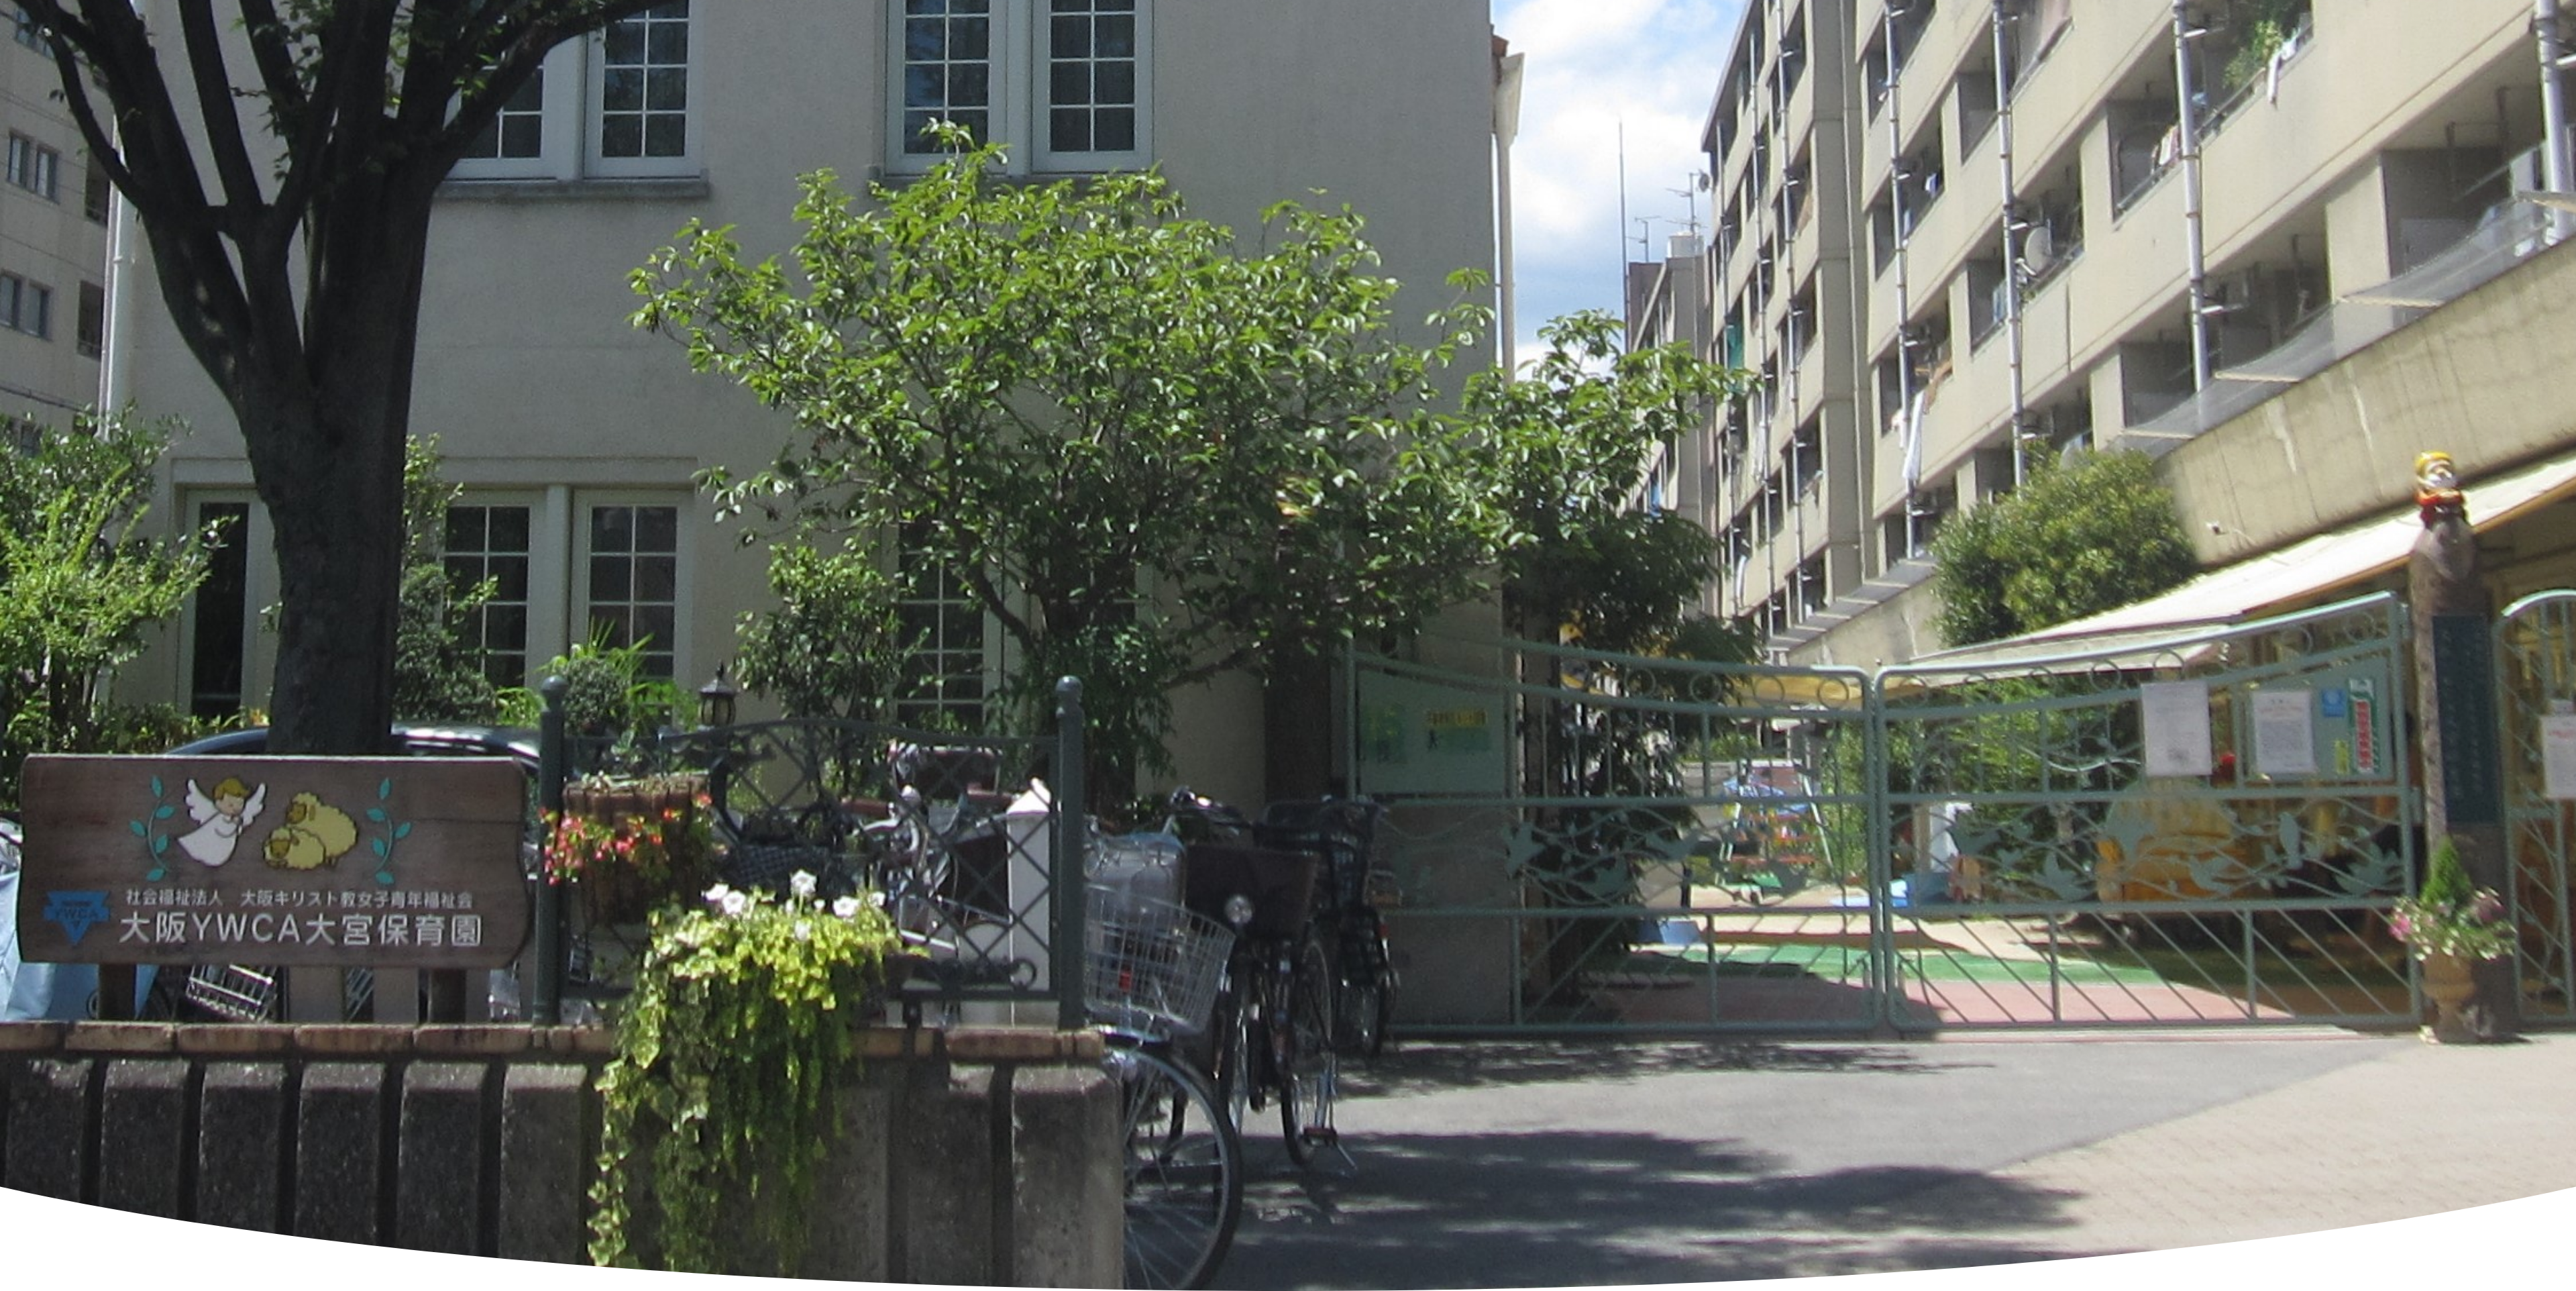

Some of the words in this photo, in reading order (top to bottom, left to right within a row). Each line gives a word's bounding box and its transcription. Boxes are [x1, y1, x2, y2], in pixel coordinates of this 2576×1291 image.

[126, 888, 223, 906] 社会福祉法人
[240, 890, 473, 909] 大阪キリスト教女子青年福祉会
[119, 911, 482, 947] 大阪YWCA大宮保育園
